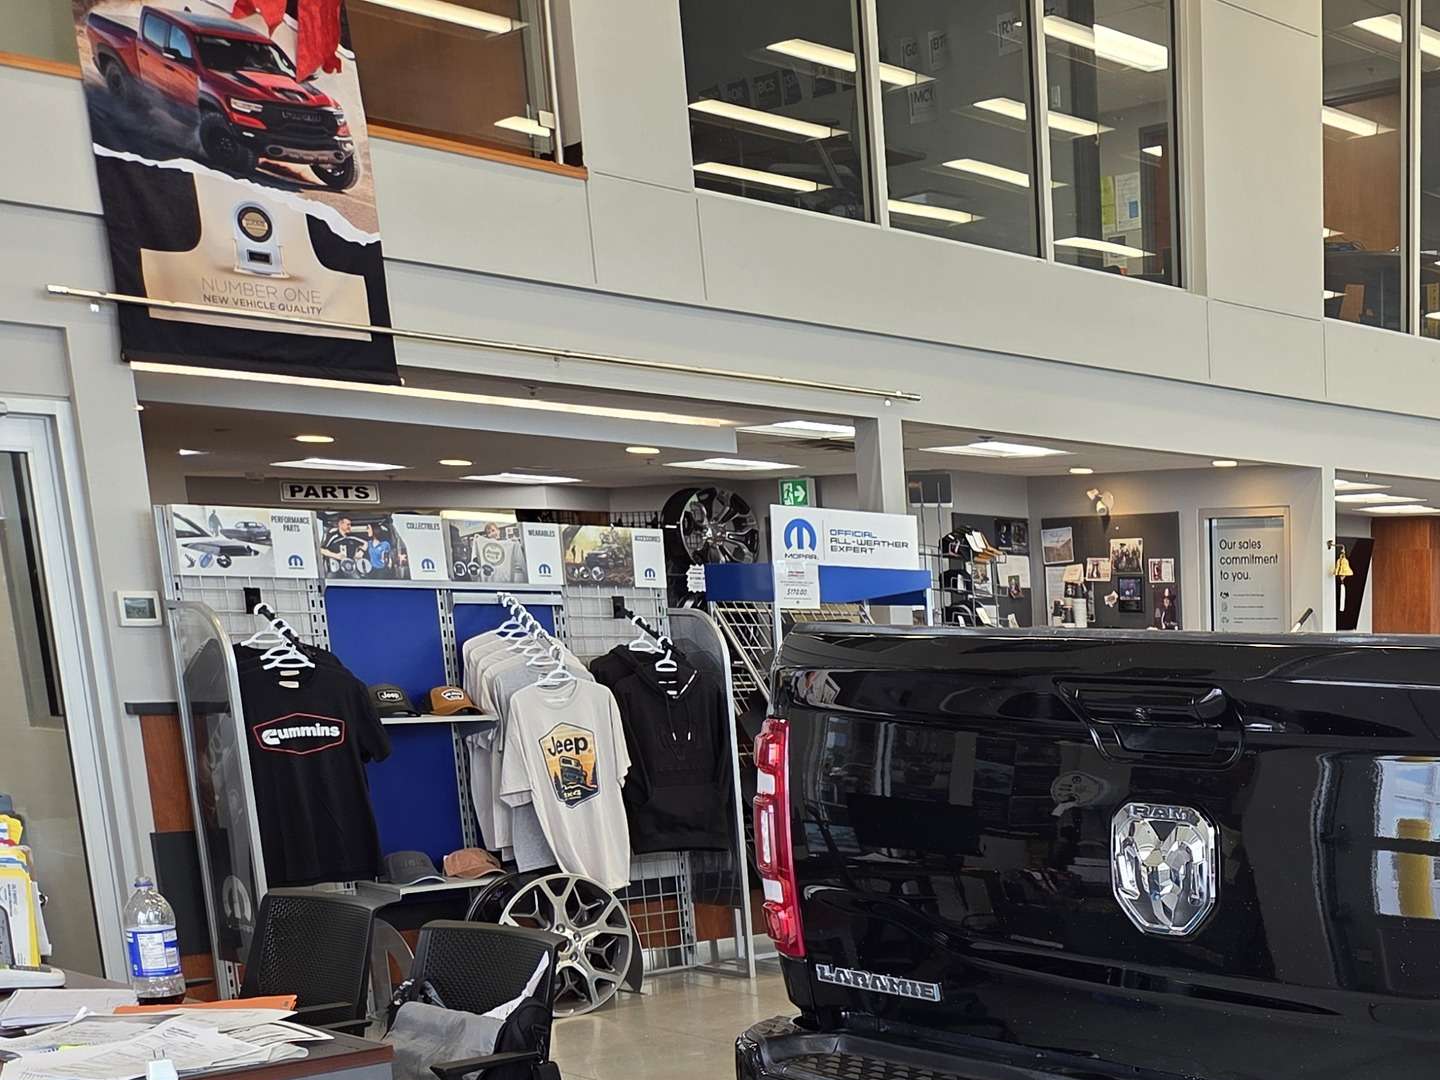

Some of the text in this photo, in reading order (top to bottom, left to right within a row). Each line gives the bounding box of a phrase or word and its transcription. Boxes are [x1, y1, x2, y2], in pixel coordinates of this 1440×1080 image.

[201, 277, 322, 305] NUMBER ONE
[203, 294, 323, 316] NEW VEHICLE QUALITY
[288, 485, 370, 500] PARTS
[271, 515, 310, 526] PERFORMANCE
[406, 521, 441, 531] COLLECTIBLES
[282, 524, 301, 533] PARTS
[527, 529, 556, 538] WEARABLES
[829, 528, 878, 539] OFFICIAL
[830, 545, 876, 555] EXPERT
[1219, 538, 1262, 550] Our sales
[1219, 553, 1279, 565] commitment
[1220, 569, 1252, 582] to you.
[380, 689, 401, 700] Jeep
[261, 722, 341, 746] Cummins
[547, 735, 589, 757] Jeep
[1129, 805, 1199, 822] RAM
[815, 963, 942, 1002] LARAMIE
